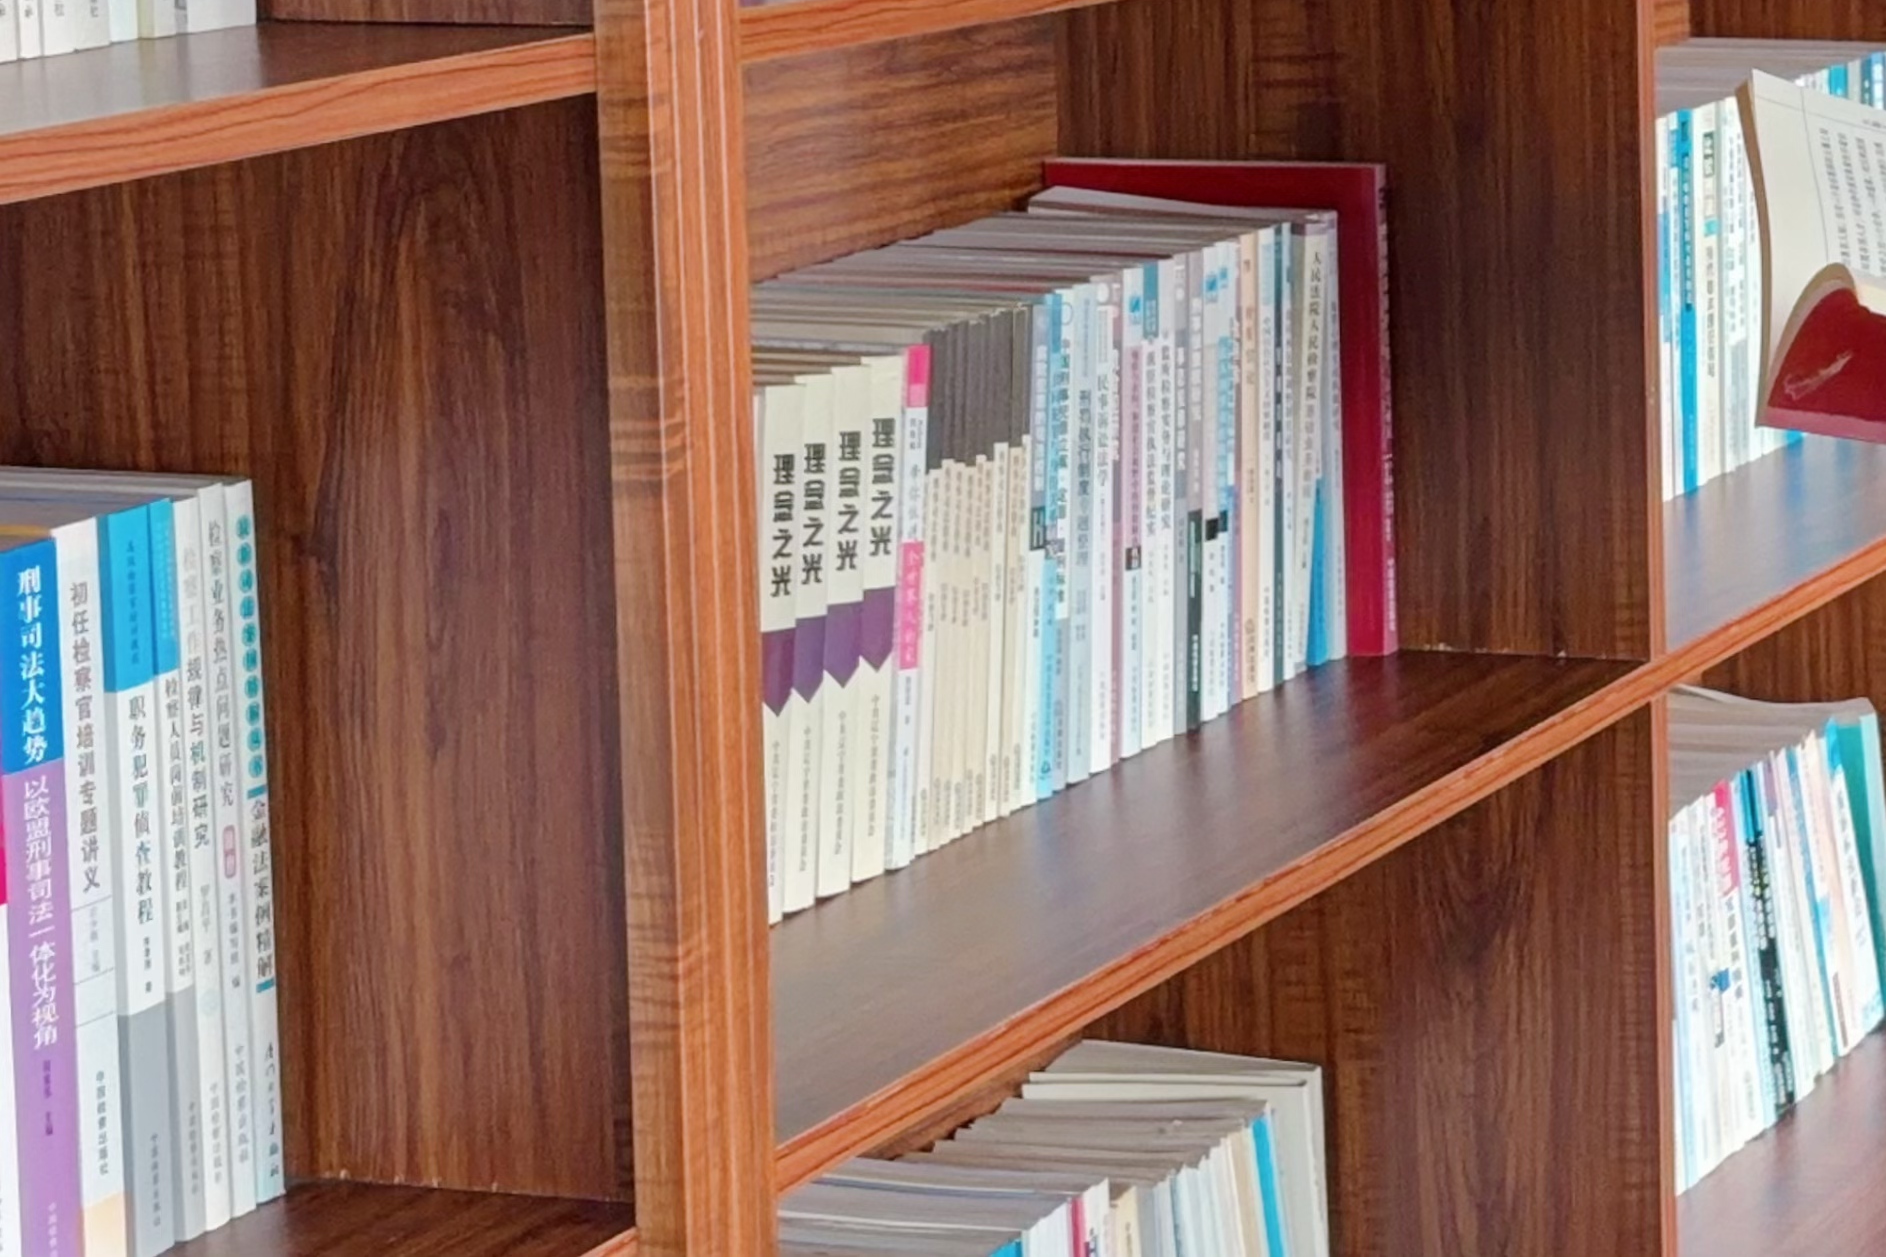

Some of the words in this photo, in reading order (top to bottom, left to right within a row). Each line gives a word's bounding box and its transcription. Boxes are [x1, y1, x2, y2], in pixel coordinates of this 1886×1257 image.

[17, 565, 48, 765] 刑事司法大趋势
[69, 582, 101, 894] 初任检察官培训专题讲义
[23, 779, 59, 1051] 以欧盟刑事司法一体化为视角
[128, 695, 153, 925] 职务犯罪侦查教程
